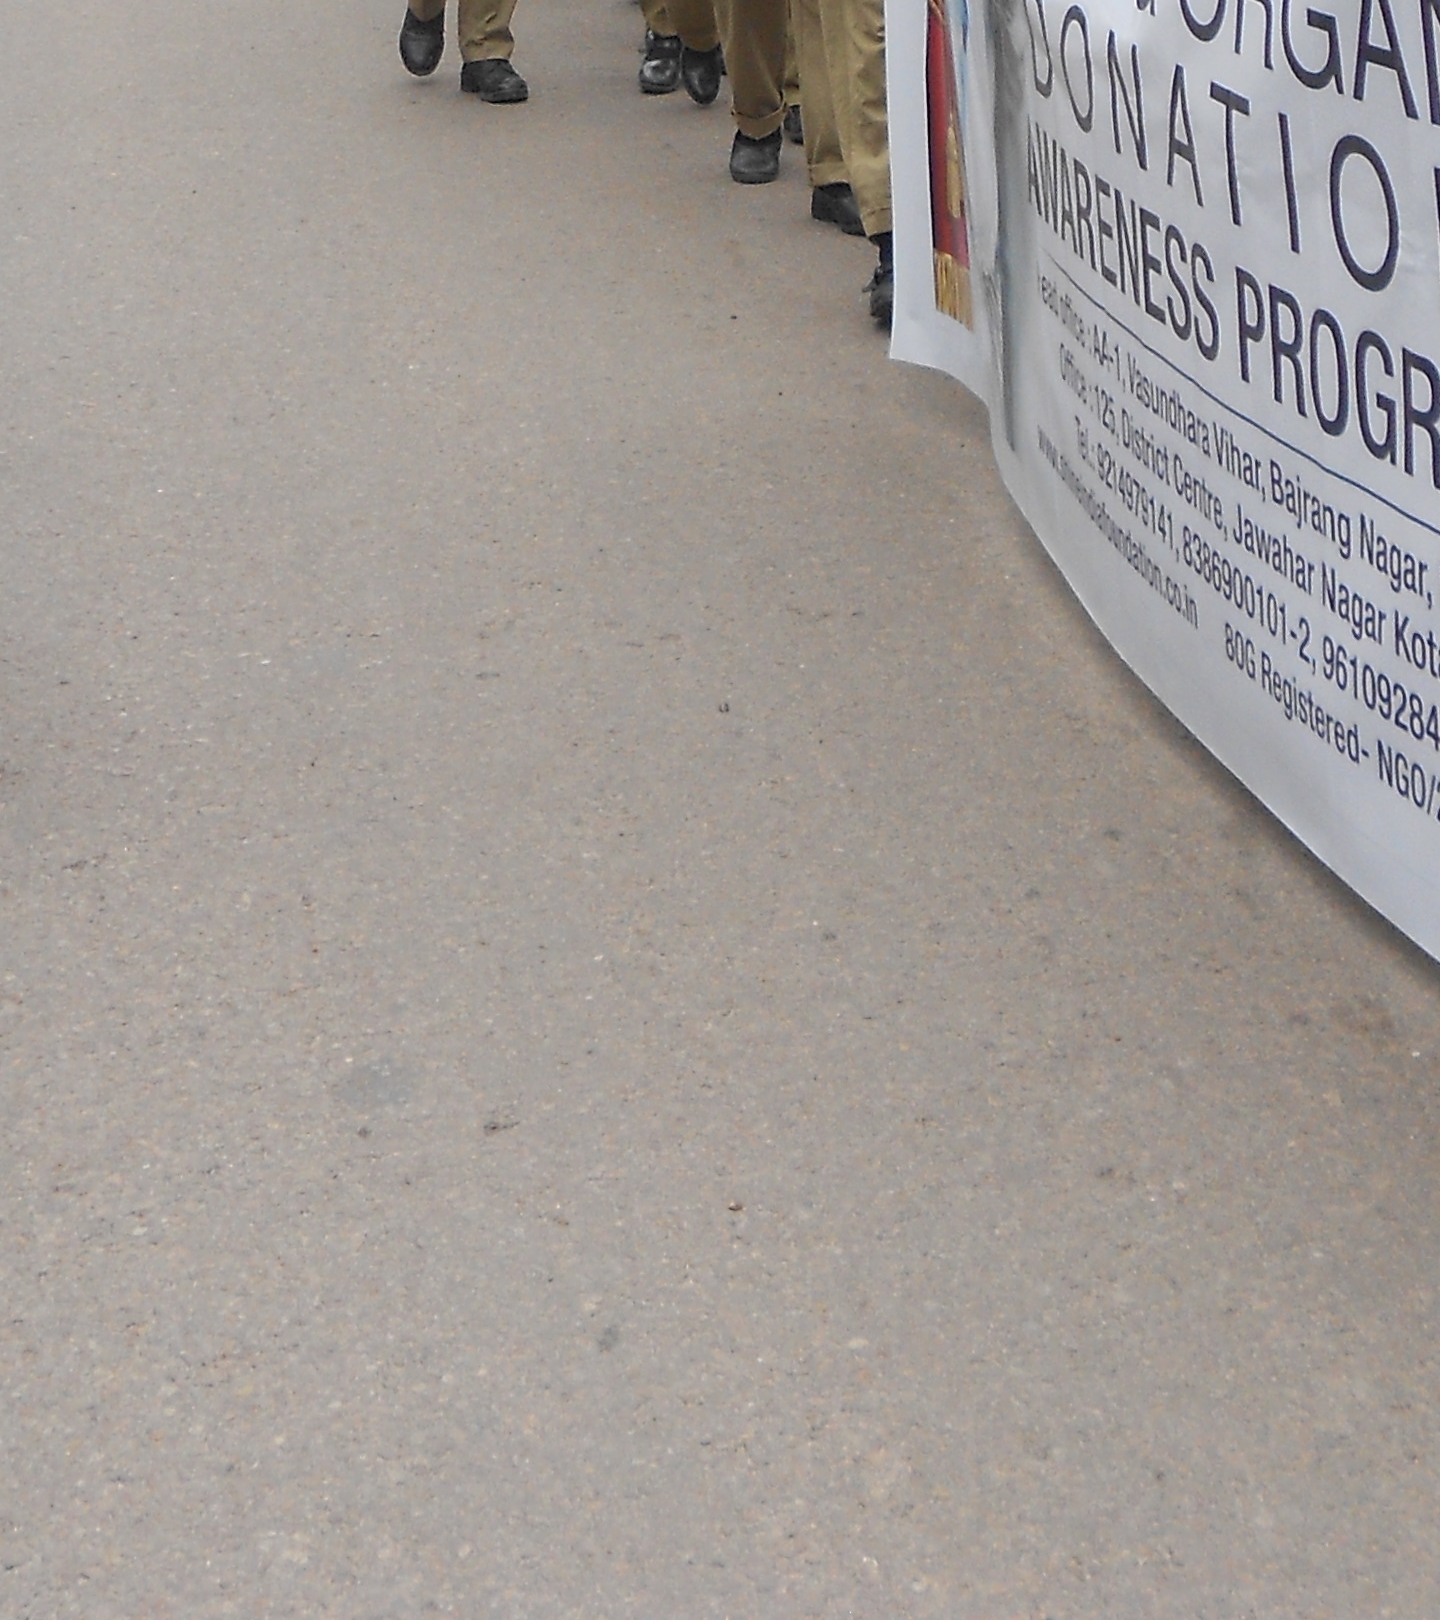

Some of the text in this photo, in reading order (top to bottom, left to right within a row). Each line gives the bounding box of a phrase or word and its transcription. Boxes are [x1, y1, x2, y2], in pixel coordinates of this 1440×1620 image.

[1027, 114, 1220, 362] AWARENESS
[1122, 407, 1171, 486] District
[1174, 453, 1228, 541] Centre,
[1233, 503, 1315, 596] Jawahar
[1322, 567, 1386, 640] Nagar
[1127, 352, 1211, 458] Vasundhara
[1213, 422, 1266, 502] Vihar,
[1270, 460, 1352, 560] Bajrang
[1360, 512, 1432, 609] Nagar,
[1224, 622, 1257, 680] 80G
